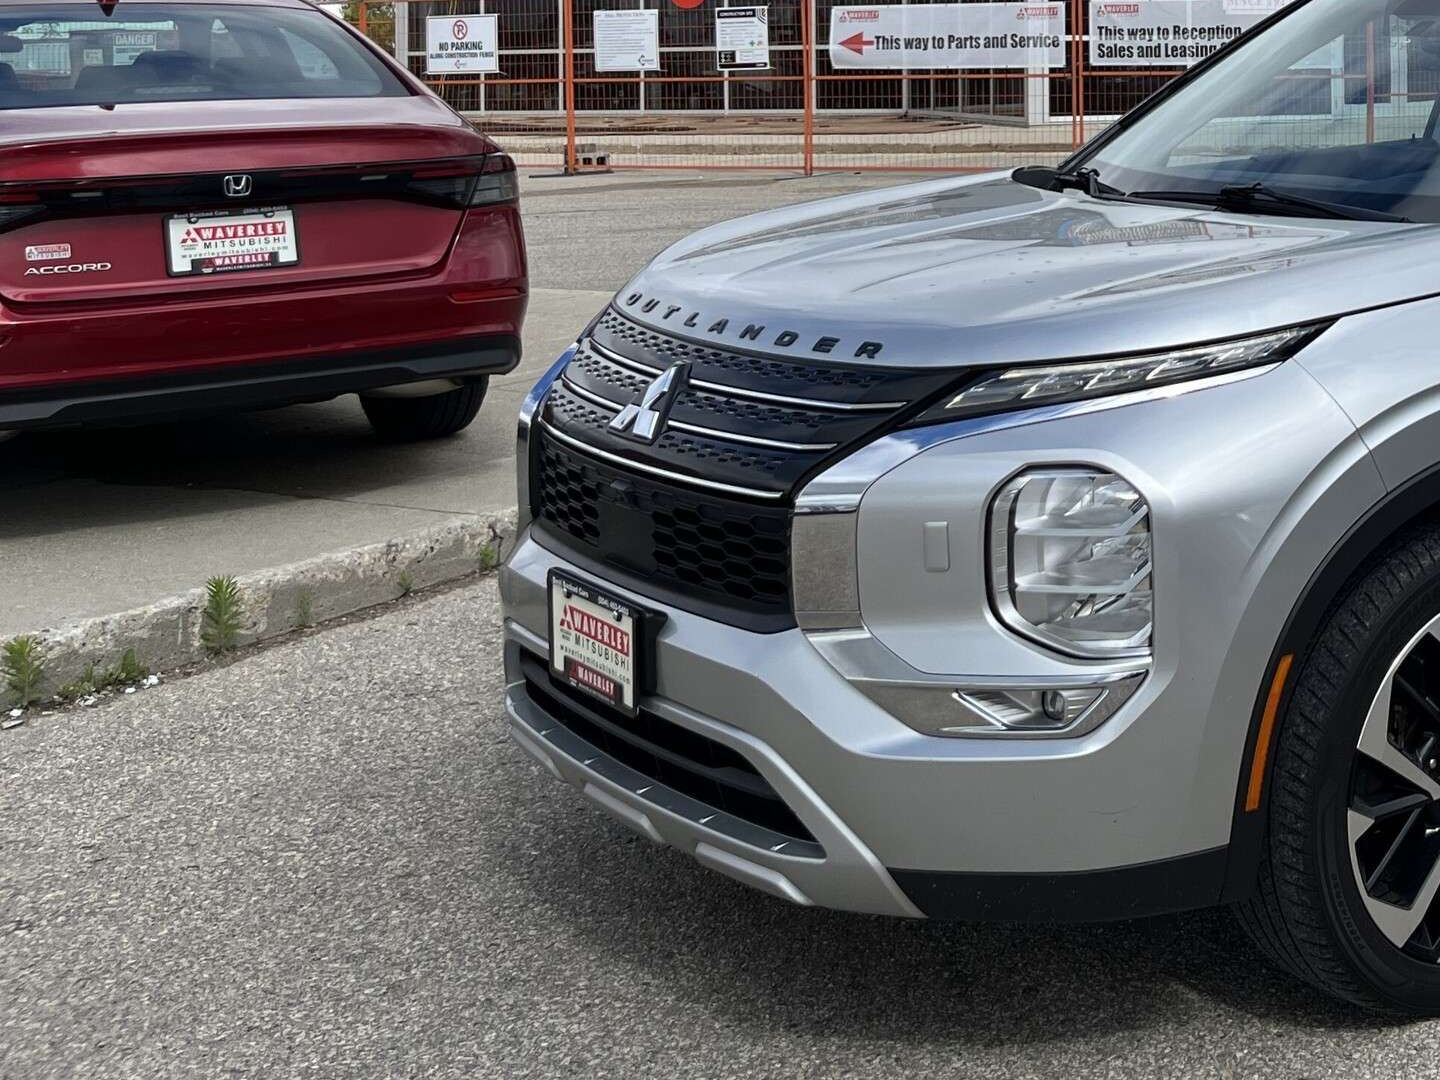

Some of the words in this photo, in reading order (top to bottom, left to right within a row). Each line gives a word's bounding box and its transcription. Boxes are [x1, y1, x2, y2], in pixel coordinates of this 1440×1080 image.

[874, 35, 901, 51] This
[904, 36, 929, 51] way
[932, 35, 945, 50] to
[948, 34, 981, 50] Parts
[983, 33, 1007, 49] and
[1010, 32, 1060, 48] Service
[1097, 26, 1124, 41] This
[1126, 28, 1153, 42] way
[1157, 26, 1169, 40] to
[1173, 25, 1242, 41] Reception
[439, 42, 449, 51] NO
[450, 41, 483, 51] PARKING
[1097, 43, 1134, 59] Sales
[1137, 43, 1162, 58] and
[201, 222, 285, 240] WAVERLEY
[203, 237, 287, 249] MITSUBISHI
[214, 253, 271, 266] WAVERLEY
[24, 262, 112, 276] ACCORD
[625, 291, 883, 359] OUTLANDER
[574, 608, 629, 654] WAVERLEY
[574, 633, 630, 672] MITSUBISHI
[577, 666, 615, 695] WAVERLEY
